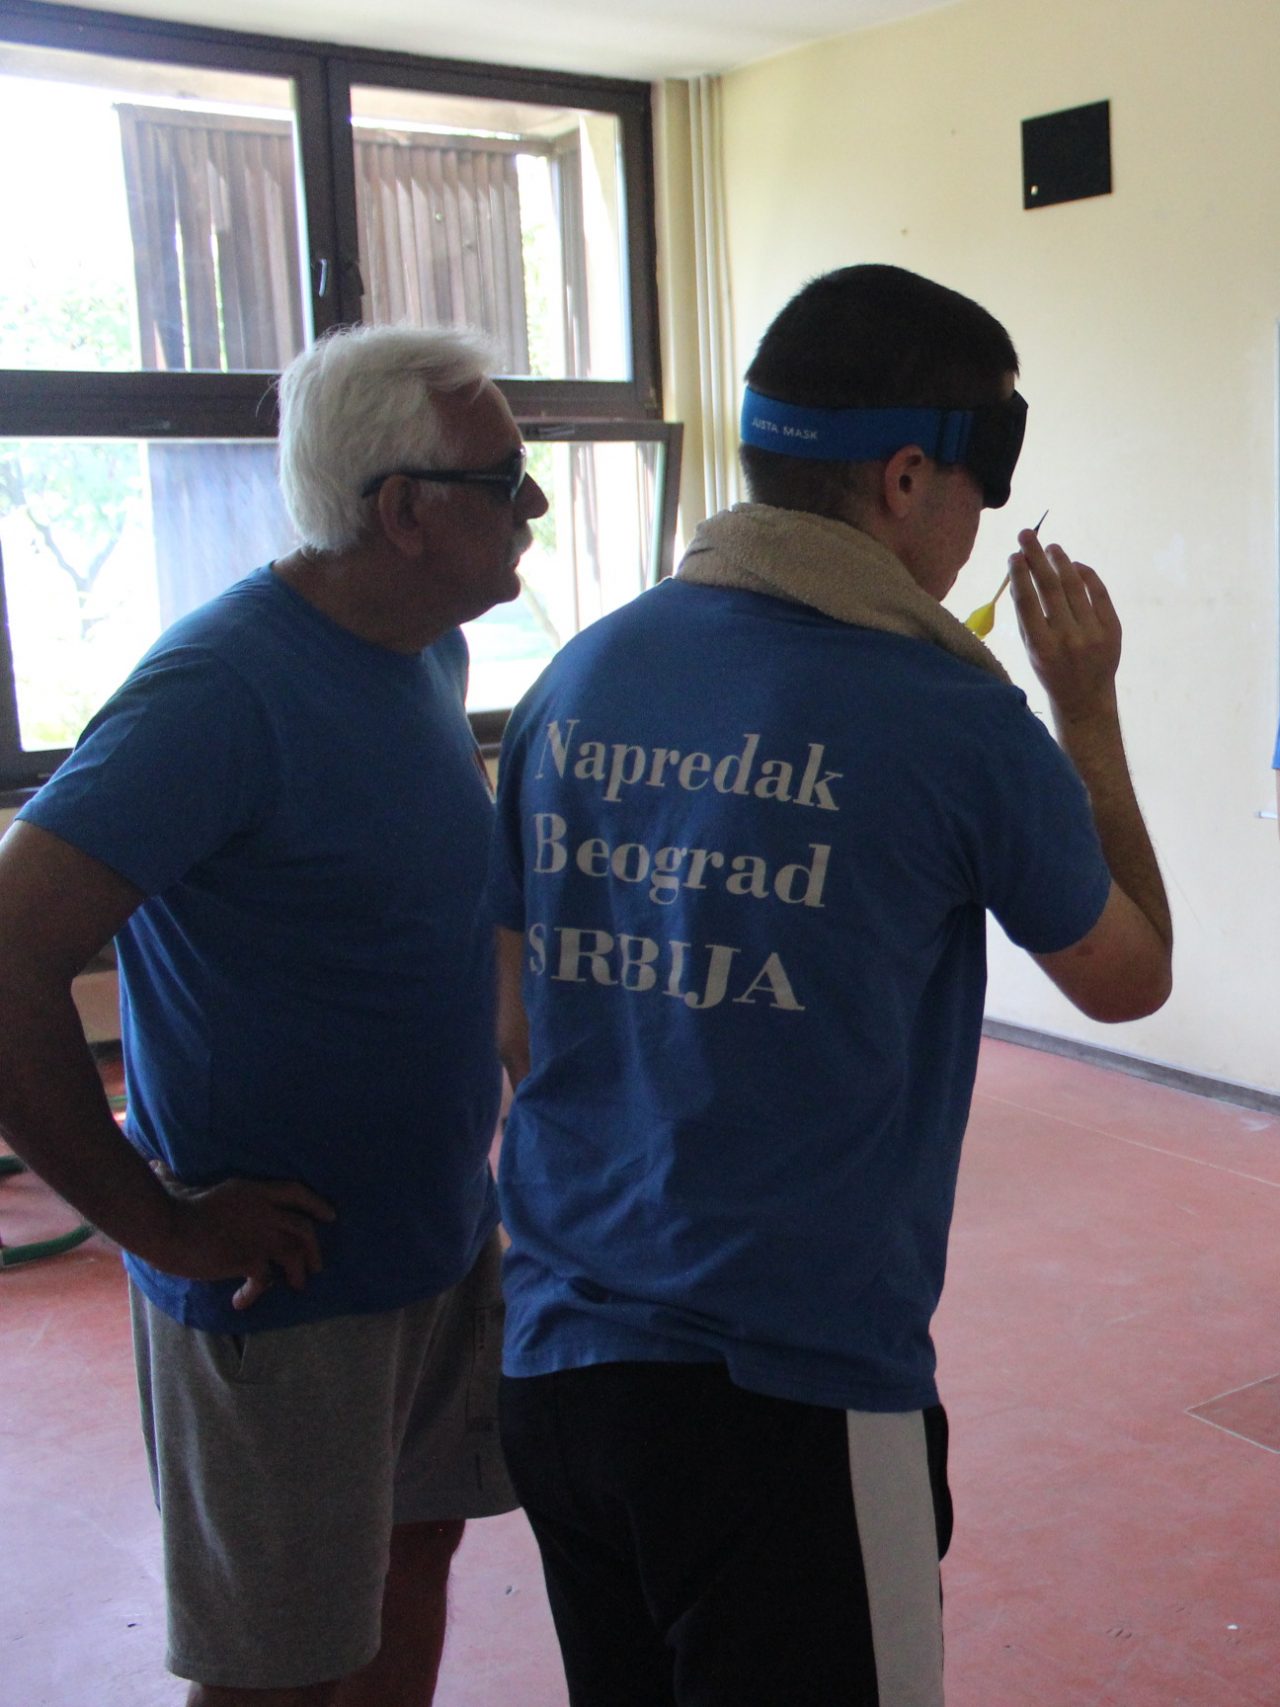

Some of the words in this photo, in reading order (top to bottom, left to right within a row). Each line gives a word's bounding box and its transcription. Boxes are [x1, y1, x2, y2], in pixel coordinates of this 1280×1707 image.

[783, 426, 818, 440] MASK
[535, 719, 843, 811] Napredak
[533, 813, 832, 908] Beograd
[529, 923, 805, 1010] SRBIJA
